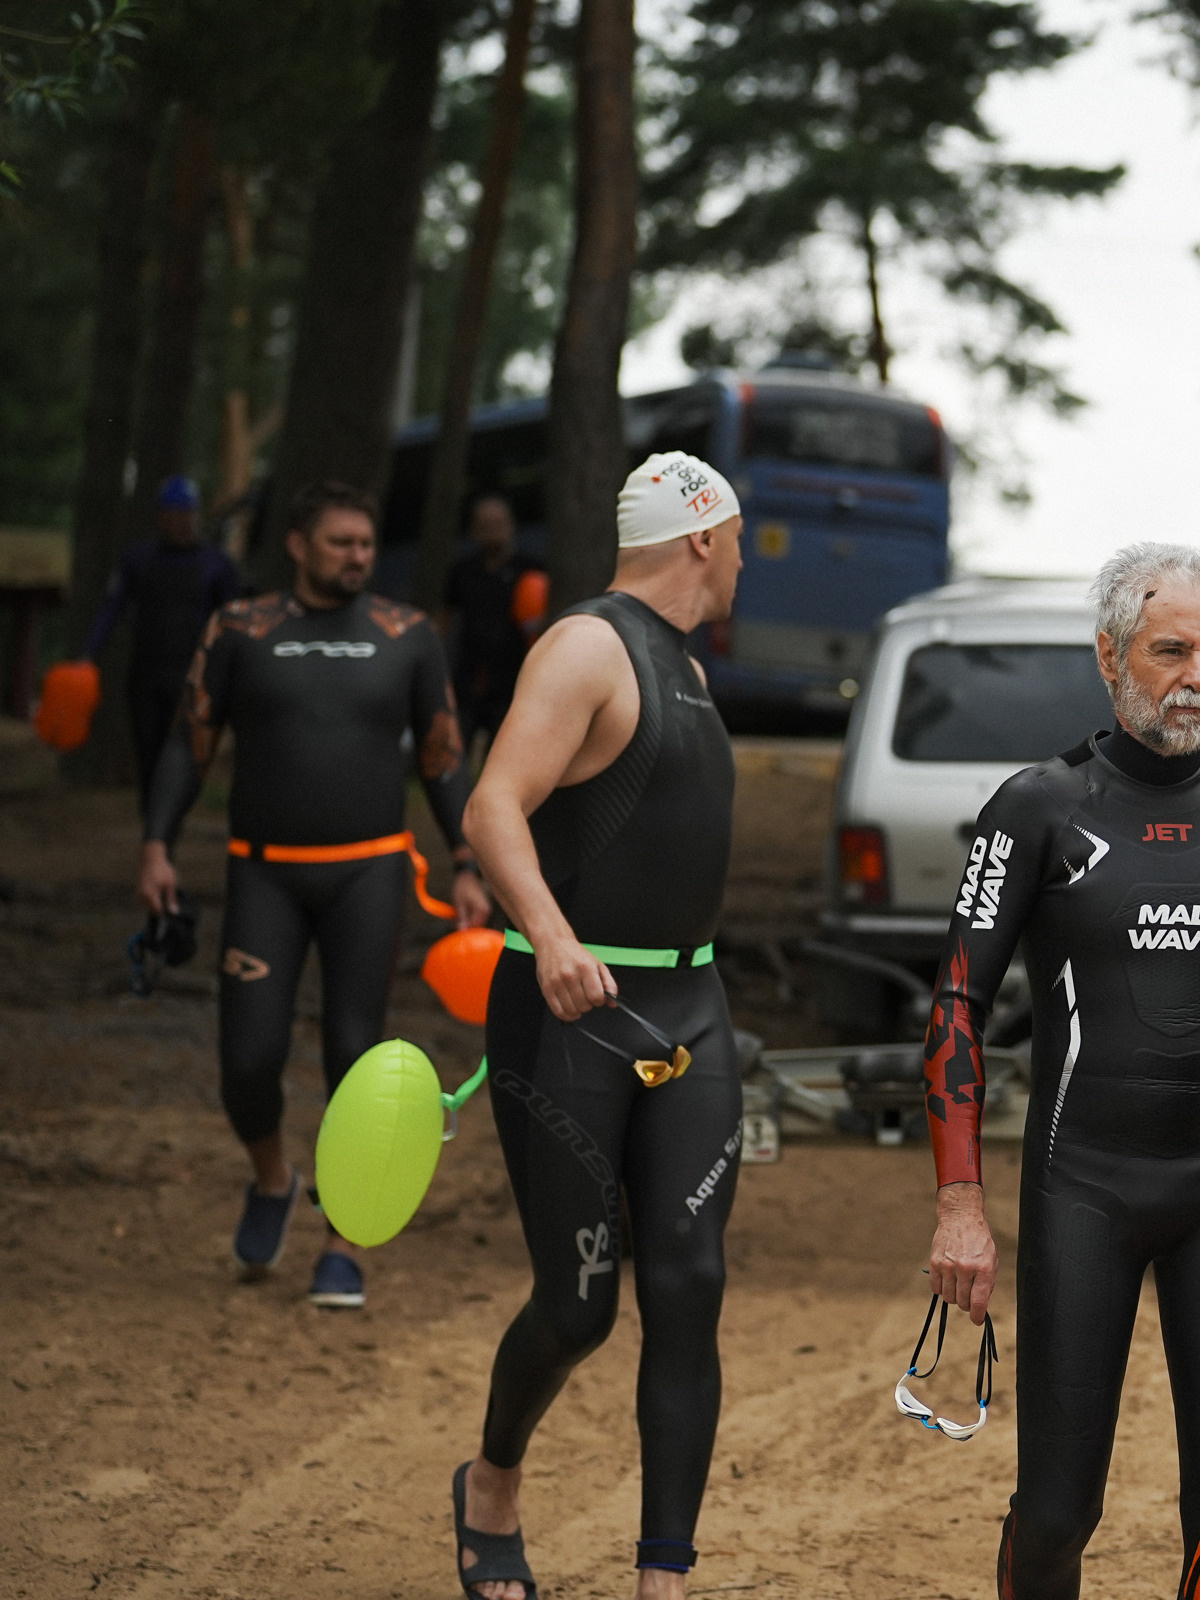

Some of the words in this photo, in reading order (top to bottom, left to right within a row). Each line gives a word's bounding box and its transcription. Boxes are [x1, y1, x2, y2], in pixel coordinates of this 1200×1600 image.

[1142, 823, 1193, 842] JET
[956, 836, 988, 918] MAD
[971, 830, 1014, 930] WAVE
[685, 1157, 728, 1216] Aqua
